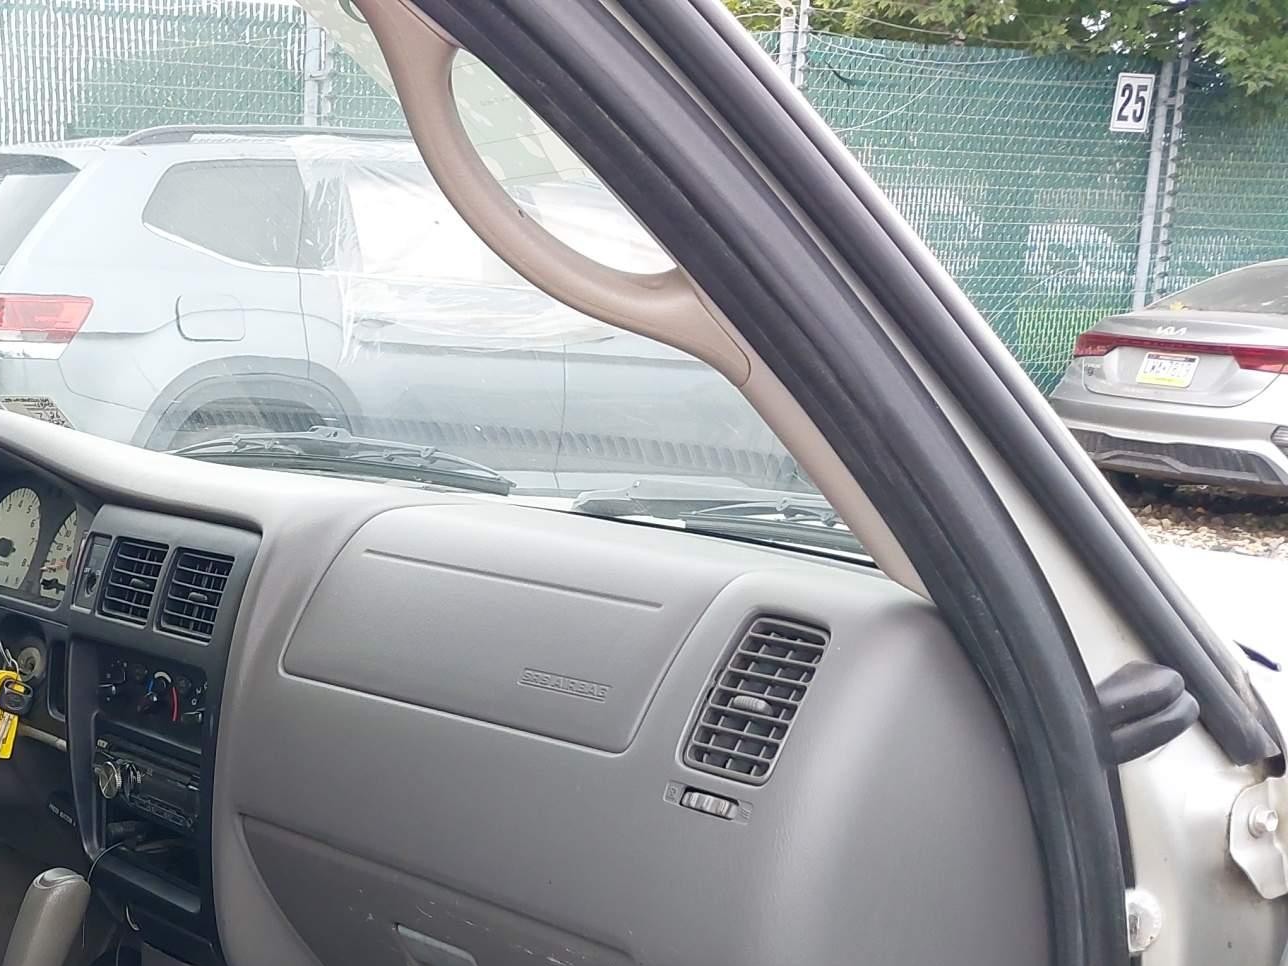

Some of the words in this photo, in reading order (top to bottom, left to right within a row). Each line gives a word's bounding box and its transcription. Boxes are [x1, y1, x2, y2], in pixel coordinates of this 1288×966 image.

[1116, 83, 1148, 123] 25
[26, 504, 33, 514] 5
[551, 676, 609, 700] AIRBAG
